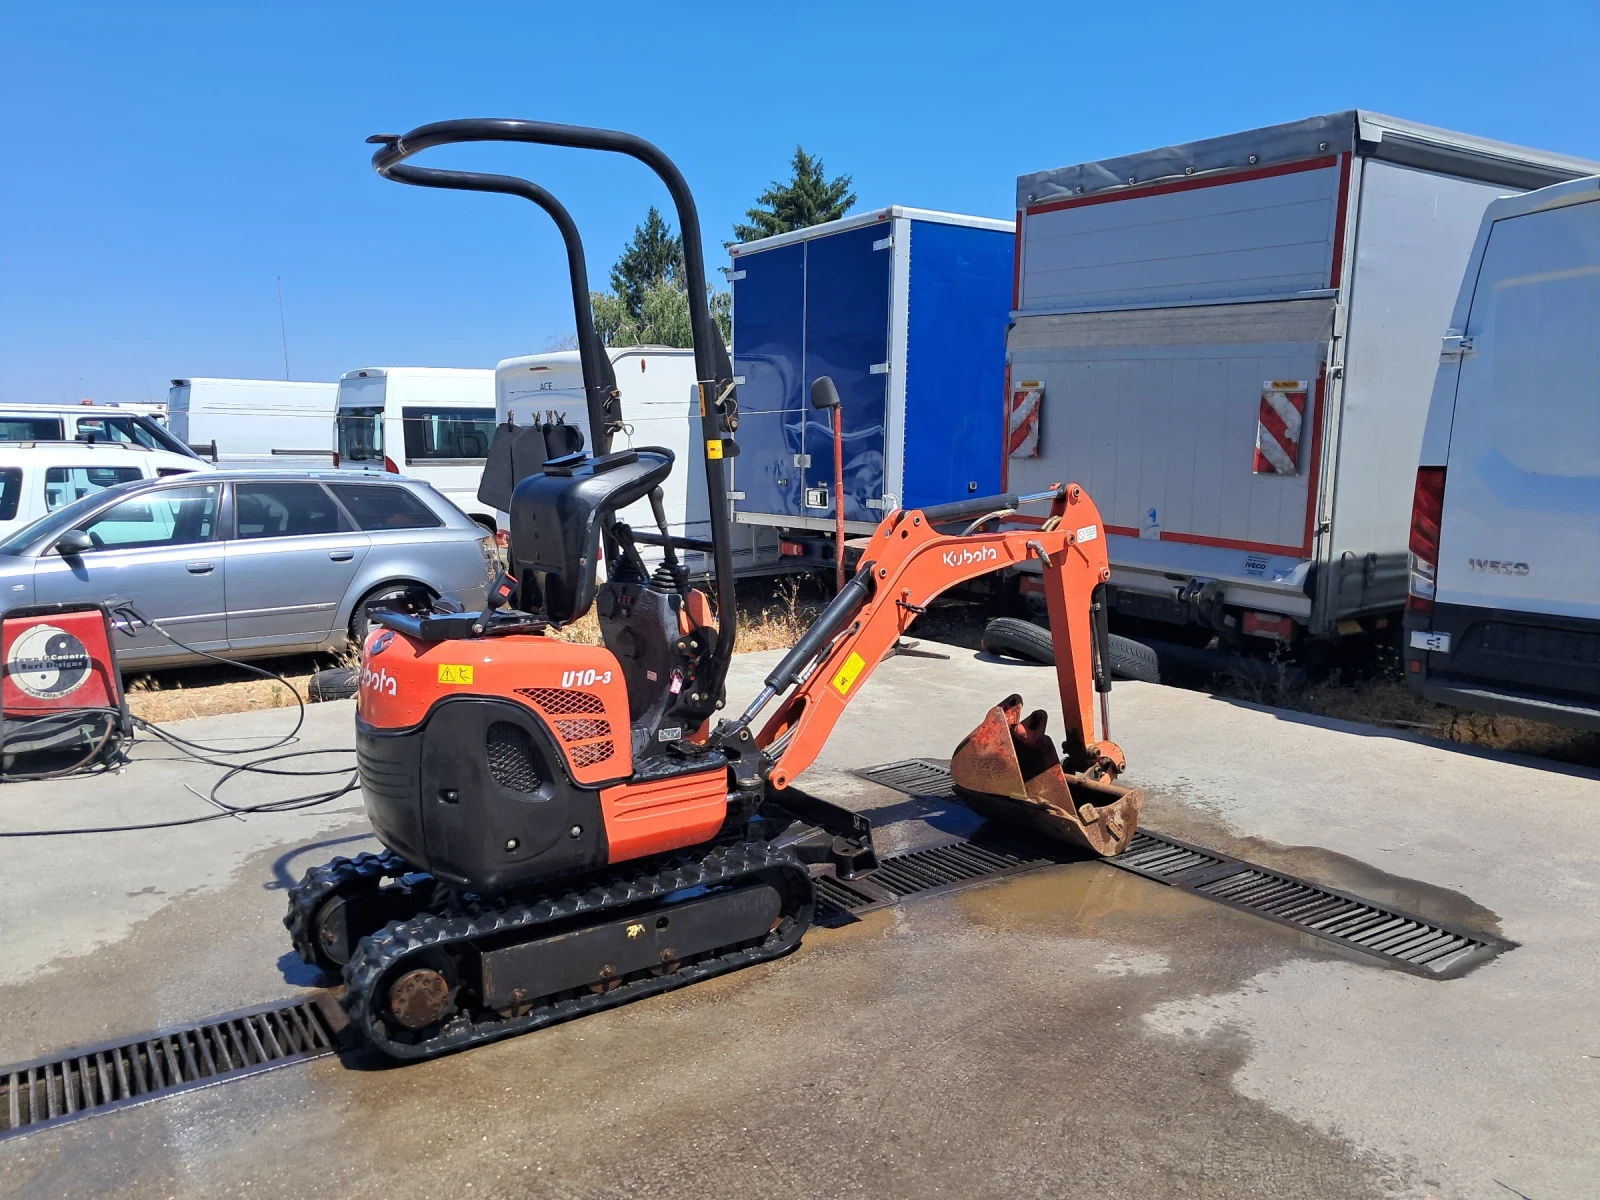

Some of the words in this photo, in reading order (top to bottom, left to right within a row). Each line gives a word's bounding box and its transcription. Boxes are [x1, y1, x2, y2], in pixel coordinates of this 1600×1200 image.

[540, 382, 552, 390] ACE
[942, 545, 997, 567] Kubota
[1468, 559, 1529, 576] IVECO
[361, 662, 396, 696] ubota
[562, 668, 612, 688] U10-3
